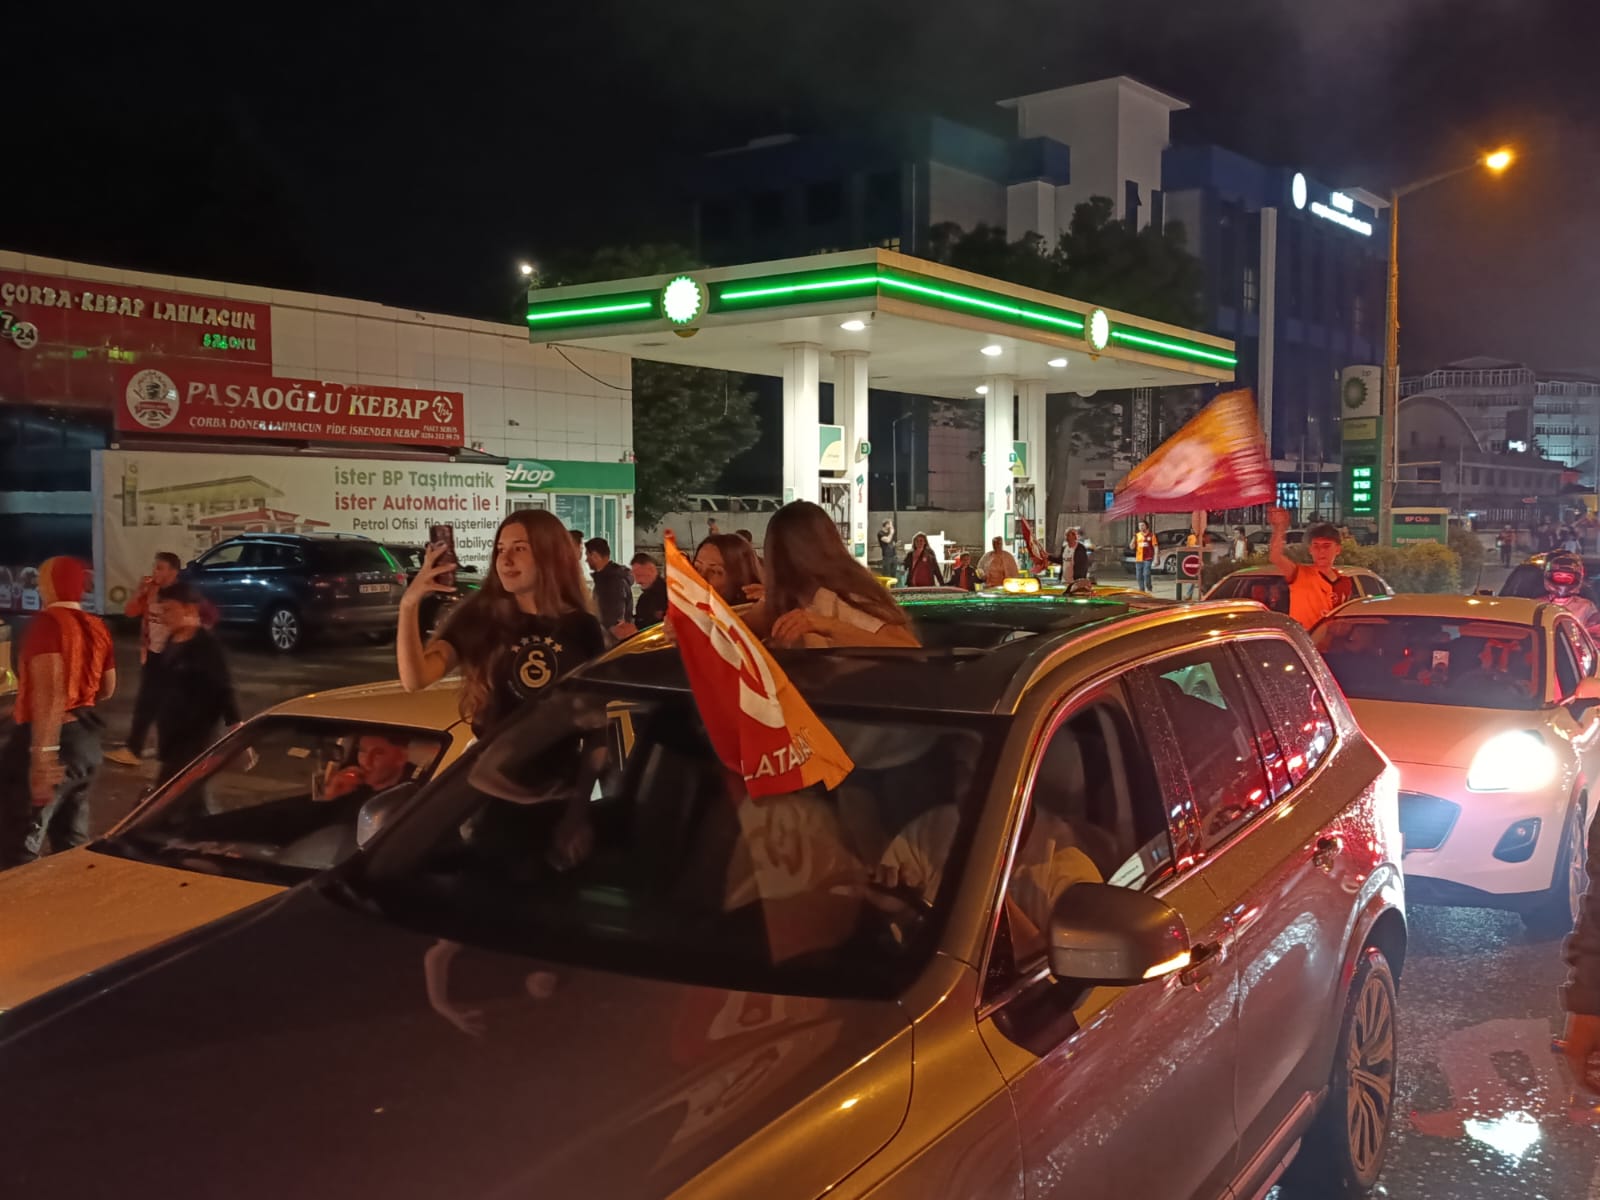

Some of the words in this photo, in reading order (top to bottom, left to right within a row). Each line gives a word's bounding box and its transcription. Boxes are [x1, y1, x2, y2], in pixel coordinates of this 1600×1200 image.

[153, 301, 256, 330] LAHMACUN
[16, 327, 35, 340] 24
[348, 393, 430, 420] KEBAP
[393, 428, 420, 439] KEBAP
[383, 471, 403, 486] BP
[409, 471, 495, 491] Taşıtmatik
[505, 464, 555, 484] shop
[383, 494, 468, 511] AutoMatic
[353, 517, 388, 530] Petrol
[391, 517, 418, 530] Ofisi
